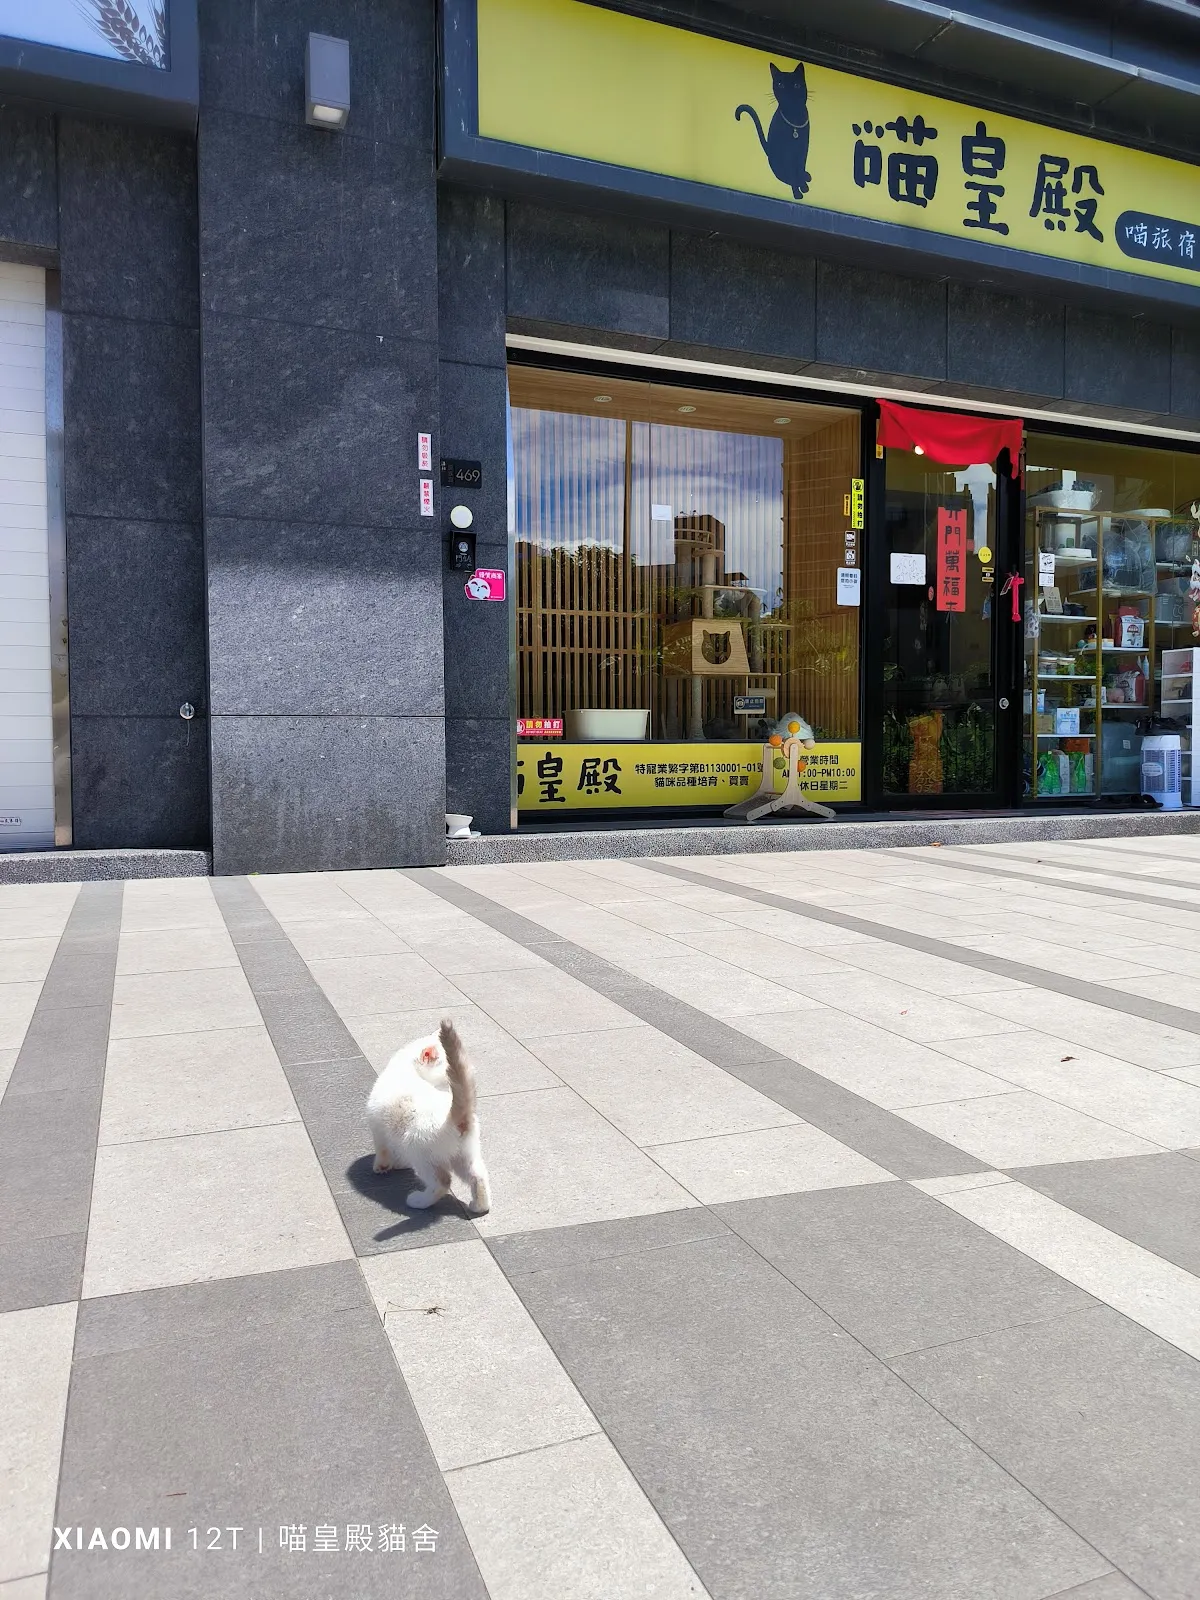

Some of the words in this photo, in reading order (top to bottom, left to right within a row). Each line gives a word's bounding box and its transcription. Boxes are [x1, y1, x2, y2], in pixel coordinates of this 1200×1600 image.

[851, 115, 1104, 242] 喵皇殿
[1125, 222, 1196, 259] 喵旅宿
[455, 468, 481, 482] 469
[654, 776, 750, 788] 貓咪品種培育、買賣
[797, 780, 848, 791] 休日星期二
